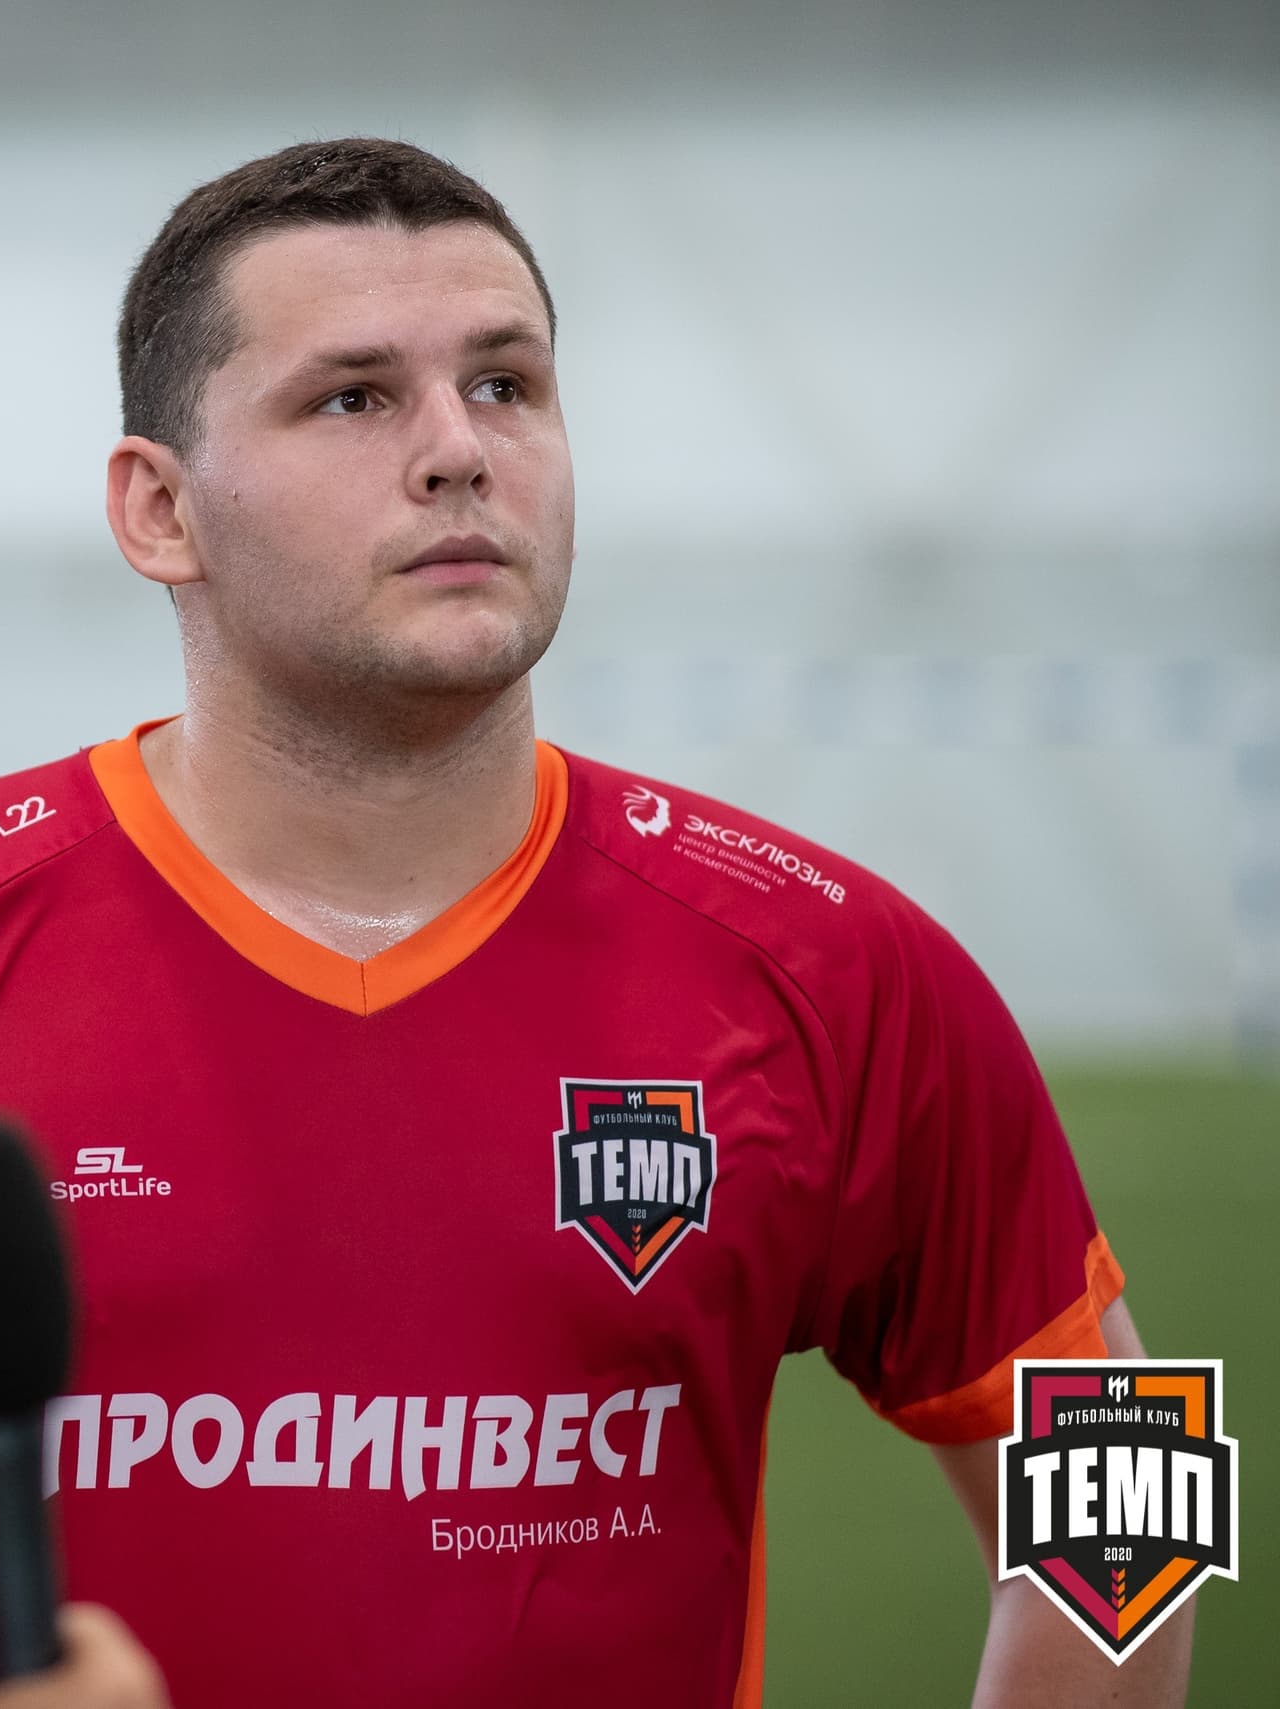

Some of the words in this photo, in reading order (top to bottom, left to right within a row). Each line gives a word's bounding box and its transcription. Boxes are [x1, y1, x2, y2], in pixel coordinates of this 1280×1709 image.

[678, 833, 716, 854] центр
[718, 849, 786, 887] внешности
[683, 848, 771, 893] косметологии
[684, 815, 846, 904] ЭКСКЛЮЗИВ
[593, 1111, 653, 1125] ФУТБОЛЬНЫЙ
[655, 1113, 678, 1126] КЛУБ
[74, 1147, 143, 1174] SL
[572, 1139, 701, 1208] ТЕМП
[50, 1177, 172, 1203] SportLife
[627, 1208, 647, 1219] 2020
[42, 1383, 682, 1501] ПРОДИНВЕСТ
[431, 1517, 599, 1560] Бродников
[609, 1503, 662, 1539] А.А.
